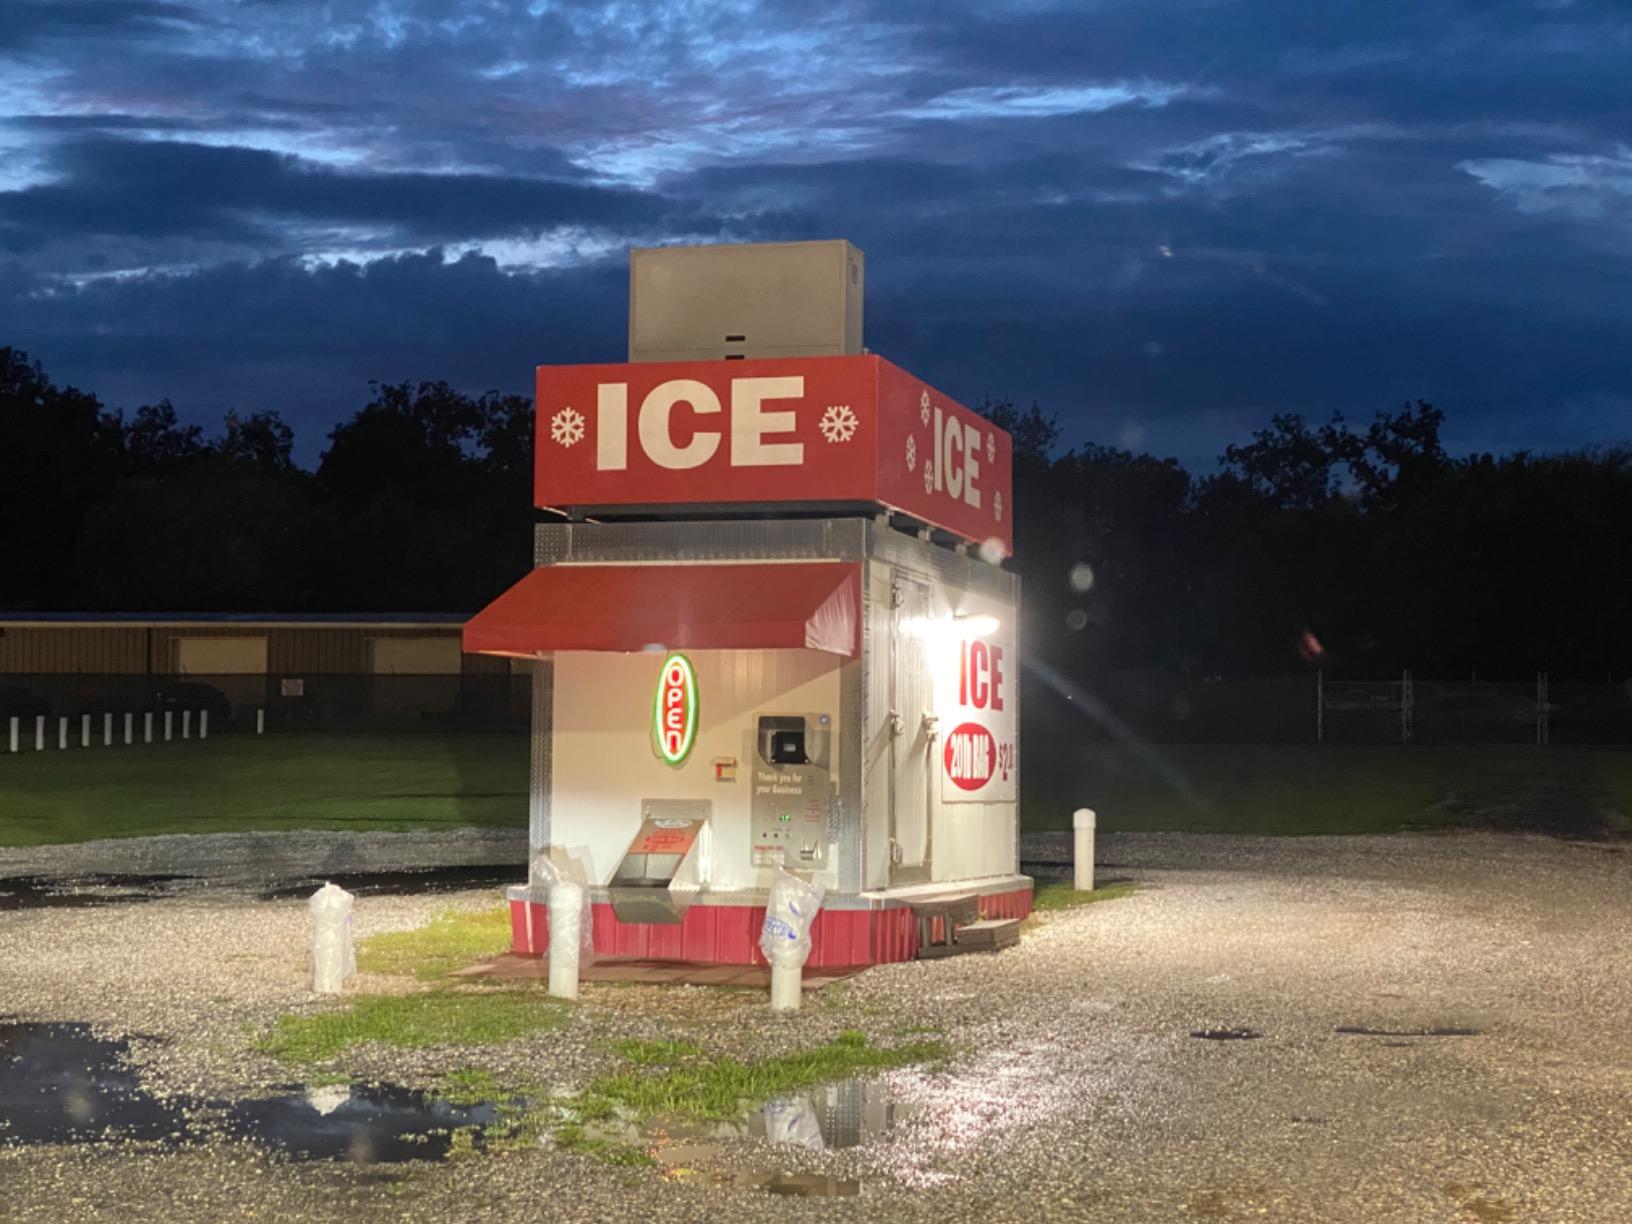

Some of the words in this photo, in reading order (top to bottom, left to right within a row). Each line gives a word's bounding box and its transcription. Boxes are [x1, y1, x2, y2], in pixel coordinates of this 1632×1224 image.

[597, 376, 804, 471] ICE
[934, 406, 981, 509] ICE
[667, 665, 684, 754] OPEN
[960, 640, 1003, 711] ICE
